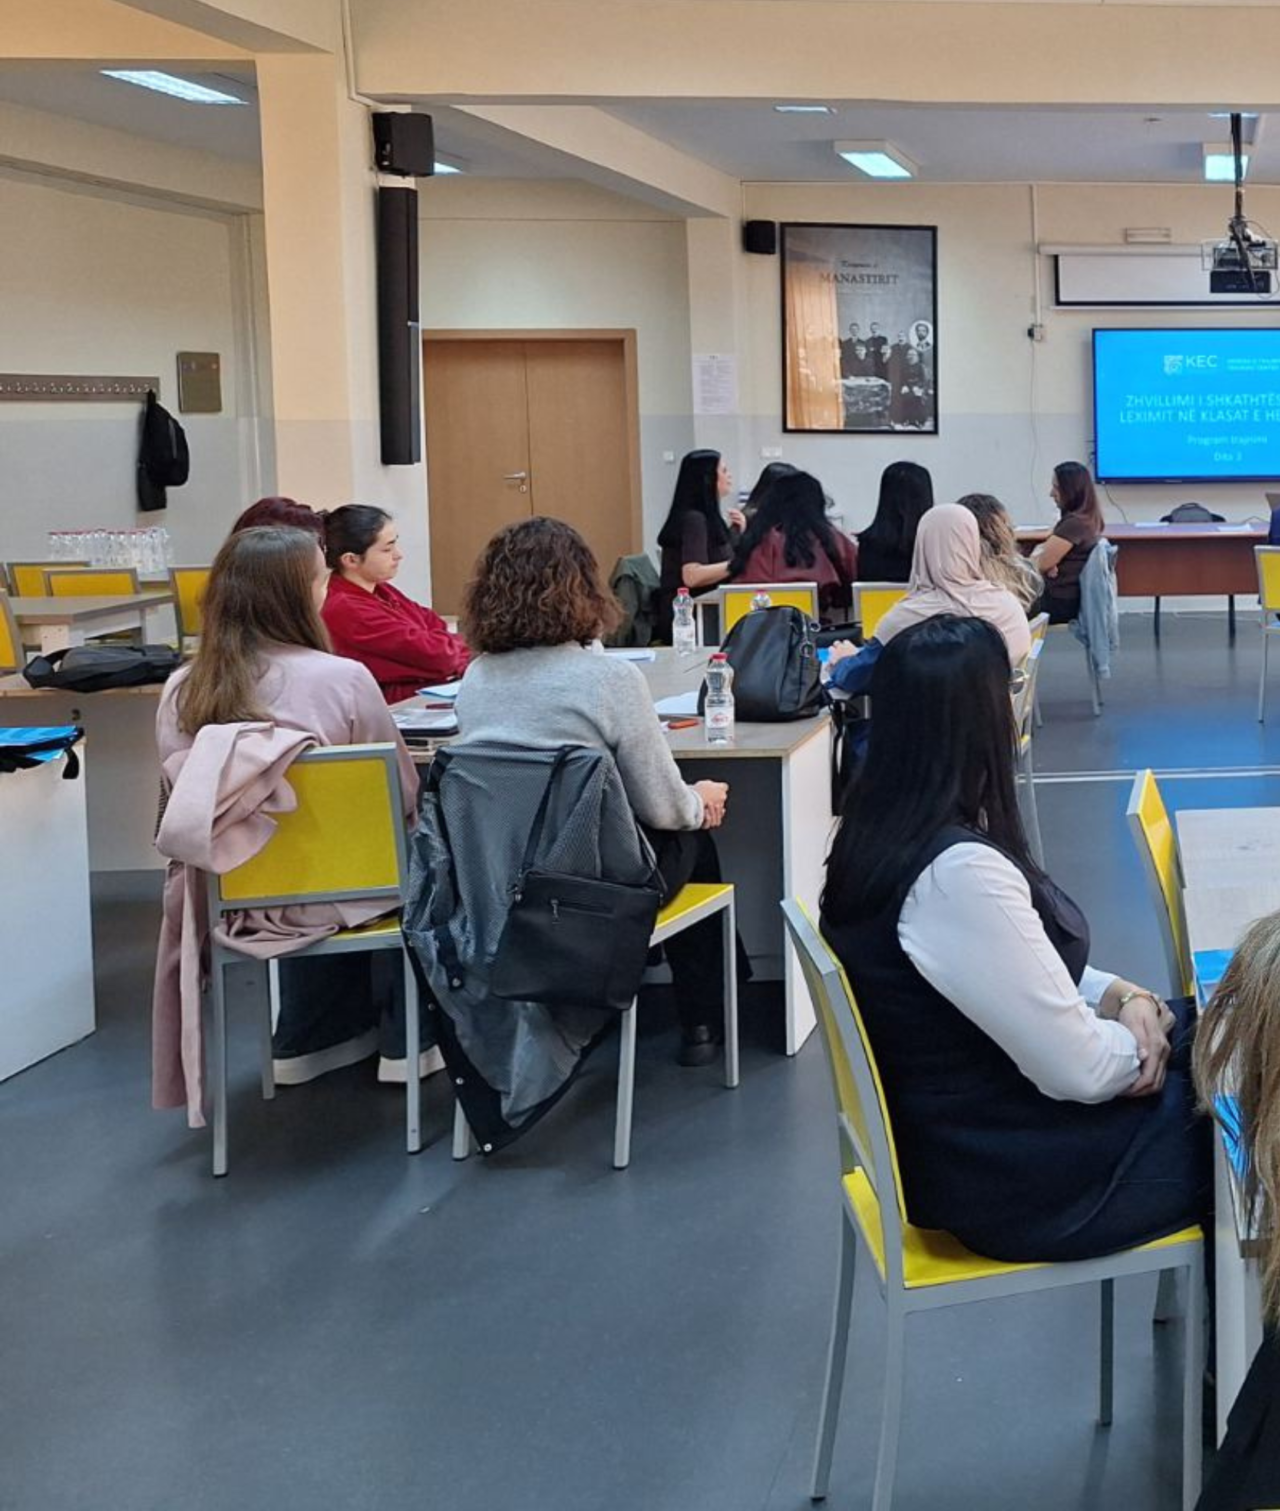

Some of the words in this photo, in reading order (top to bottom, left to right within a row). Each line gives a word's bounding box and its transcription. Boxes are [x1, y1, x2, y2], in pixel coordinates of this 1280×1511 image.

[1185, 355, 1218, 368] KEC
[1125, 394, 1195, 407] ZHVILLIMI
[1201, 409, 1249, 422] KLASAT
